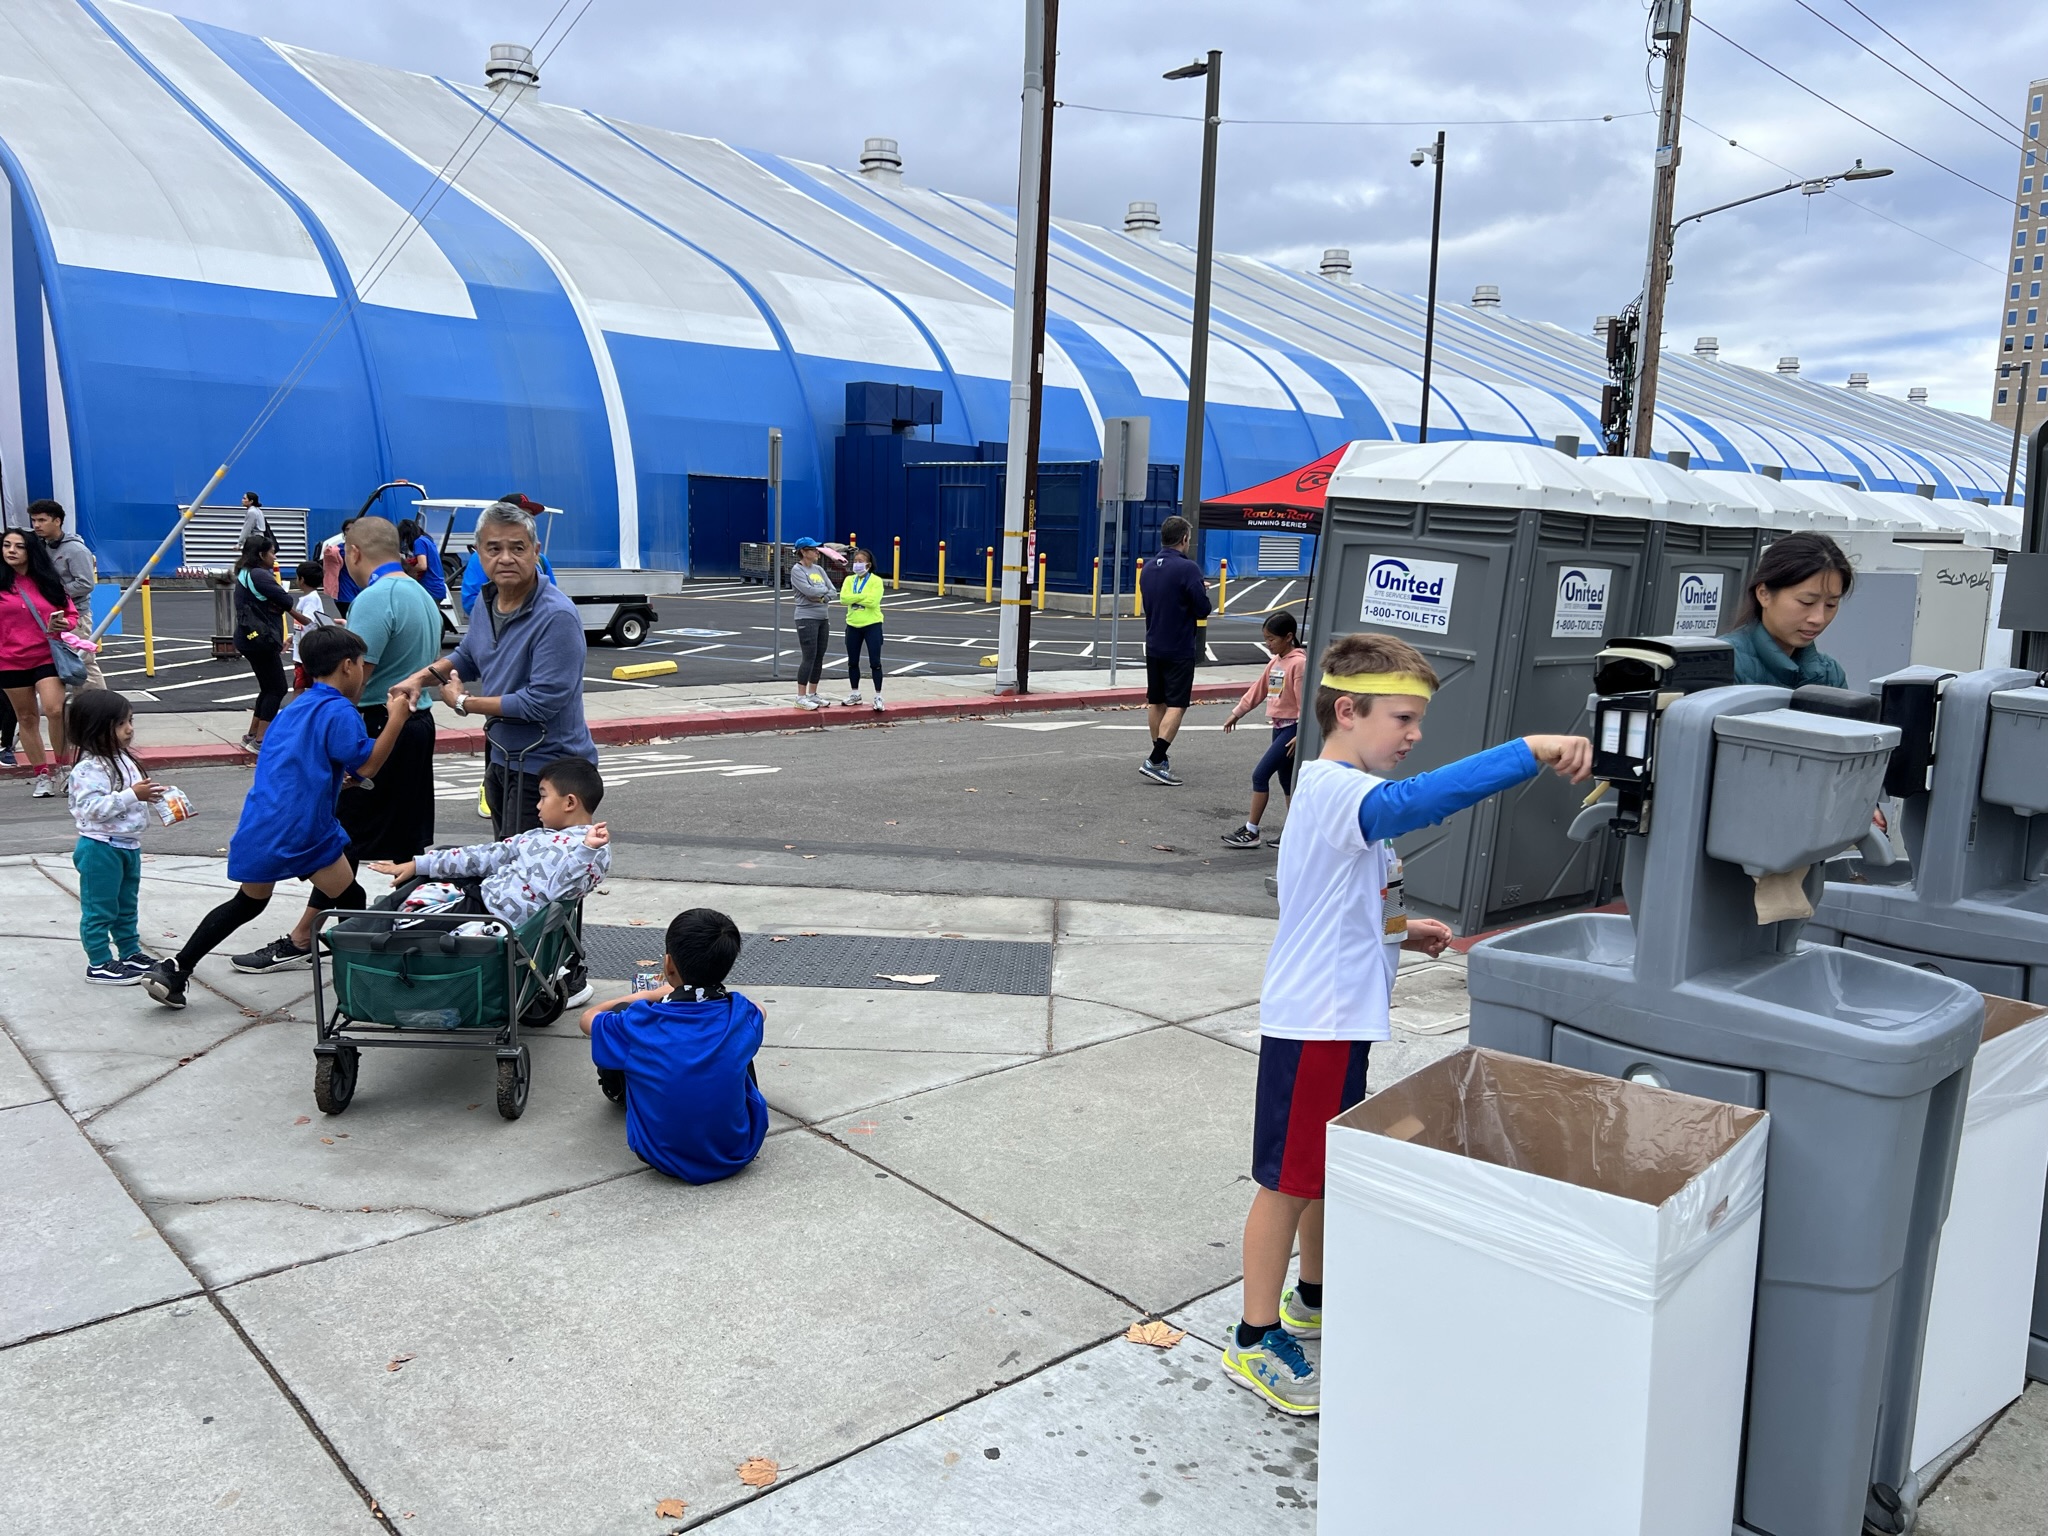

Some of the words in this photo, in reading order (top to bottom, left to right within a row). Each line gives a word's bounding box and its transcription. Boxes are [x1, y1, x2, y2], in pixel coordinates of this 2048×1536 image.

[1242, 508, 1276, 518] Rock
[1286, 509, 1315, 521] Roll
[1281, 520, 1307, 528] SERIES
[1375, 569, 1444, 597] United
[1374, 589, 1385, 597] SITE
[1385, 591, 1411, 600] SERVICES
[1565, 581, 1605, 602] United
[1685, 586, 1718, 604] United
[1364, 605, 1446, 626] 1-800-TOILETS
[1556, 619, 1603, 630] 1-800-TOILETS
[1676, 619, 1717, 630] 1-800-TOILETS
